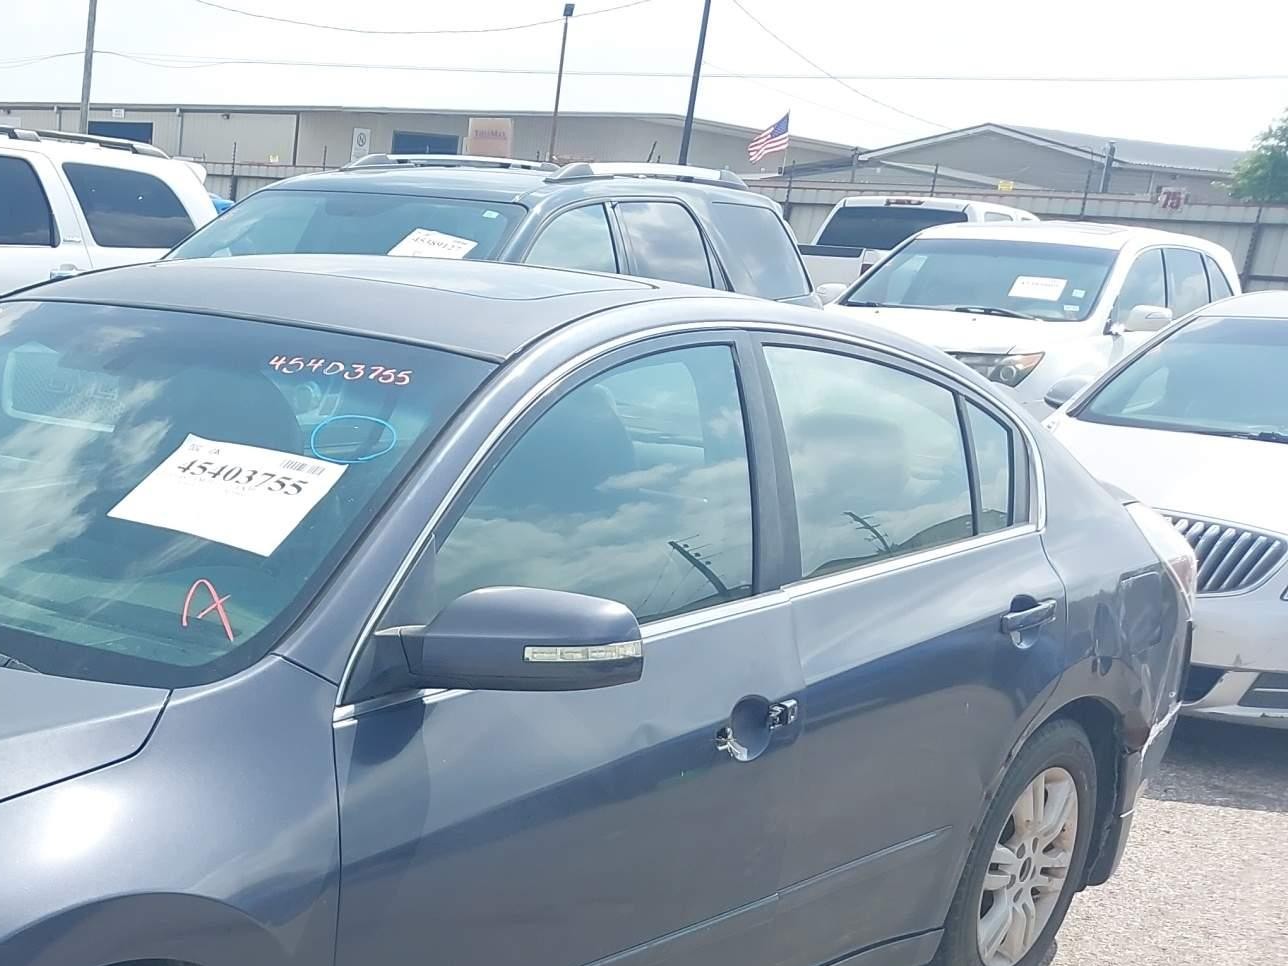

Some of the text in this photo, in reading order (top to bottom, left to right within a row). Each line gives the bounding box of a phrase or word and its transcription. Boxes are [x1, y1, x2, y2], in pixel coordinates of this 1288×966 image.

[268, 355, 413, 386] 45403755
[177, 459, 308, 496] 45403755
[182, 578, 234, 642] A
